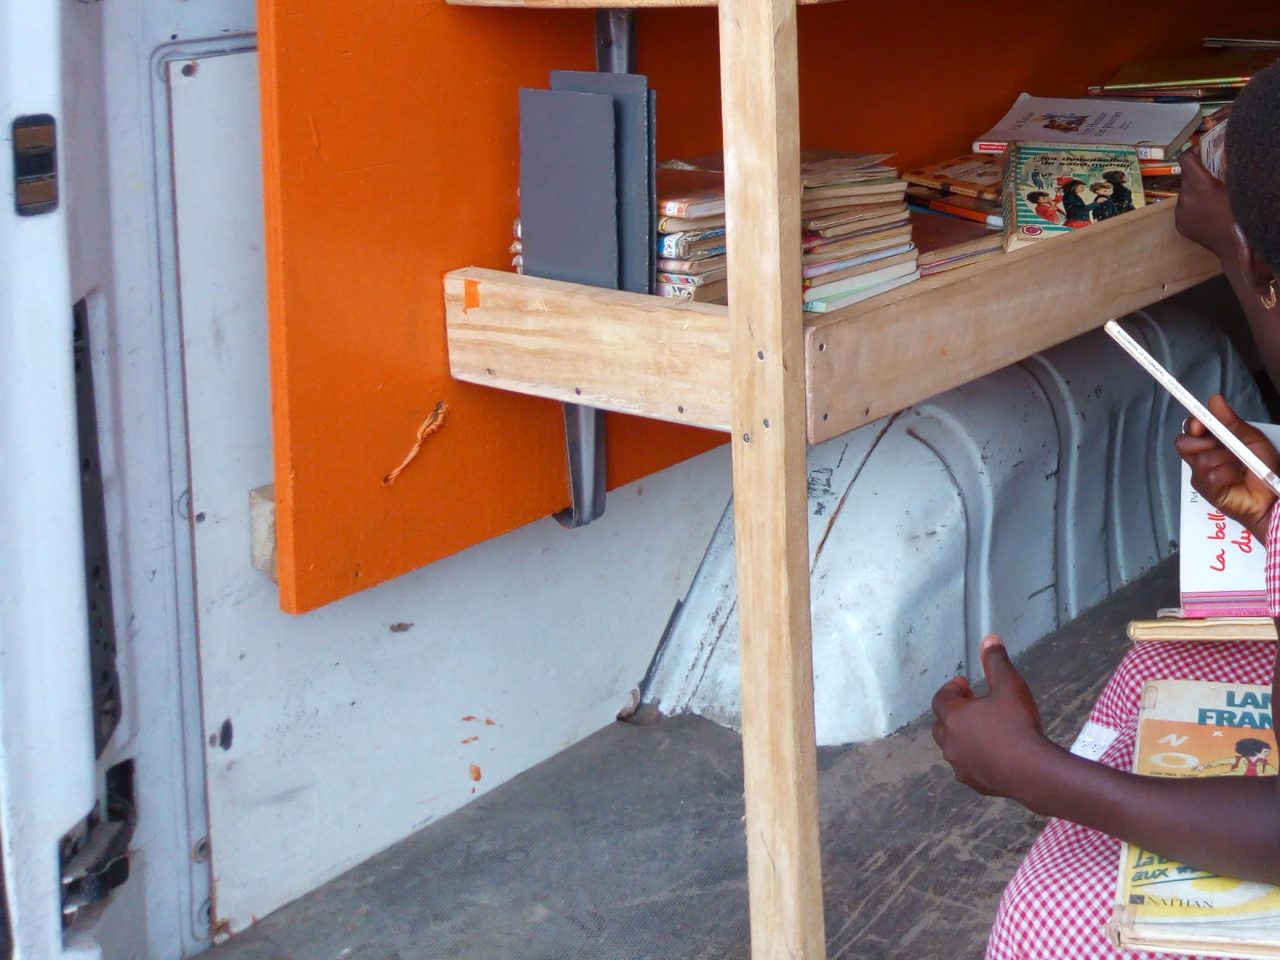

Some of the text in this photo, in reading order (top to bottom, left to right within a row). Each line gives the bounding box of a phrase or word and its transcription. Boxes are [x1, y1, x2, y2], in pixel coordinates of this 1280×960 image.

[1231, 529, 1252, 554] du
[1209, 549, 1226, 572] La
[1131, 867, 1169, 882] aux
[1145, 895, 1215, 909] NATHAN
